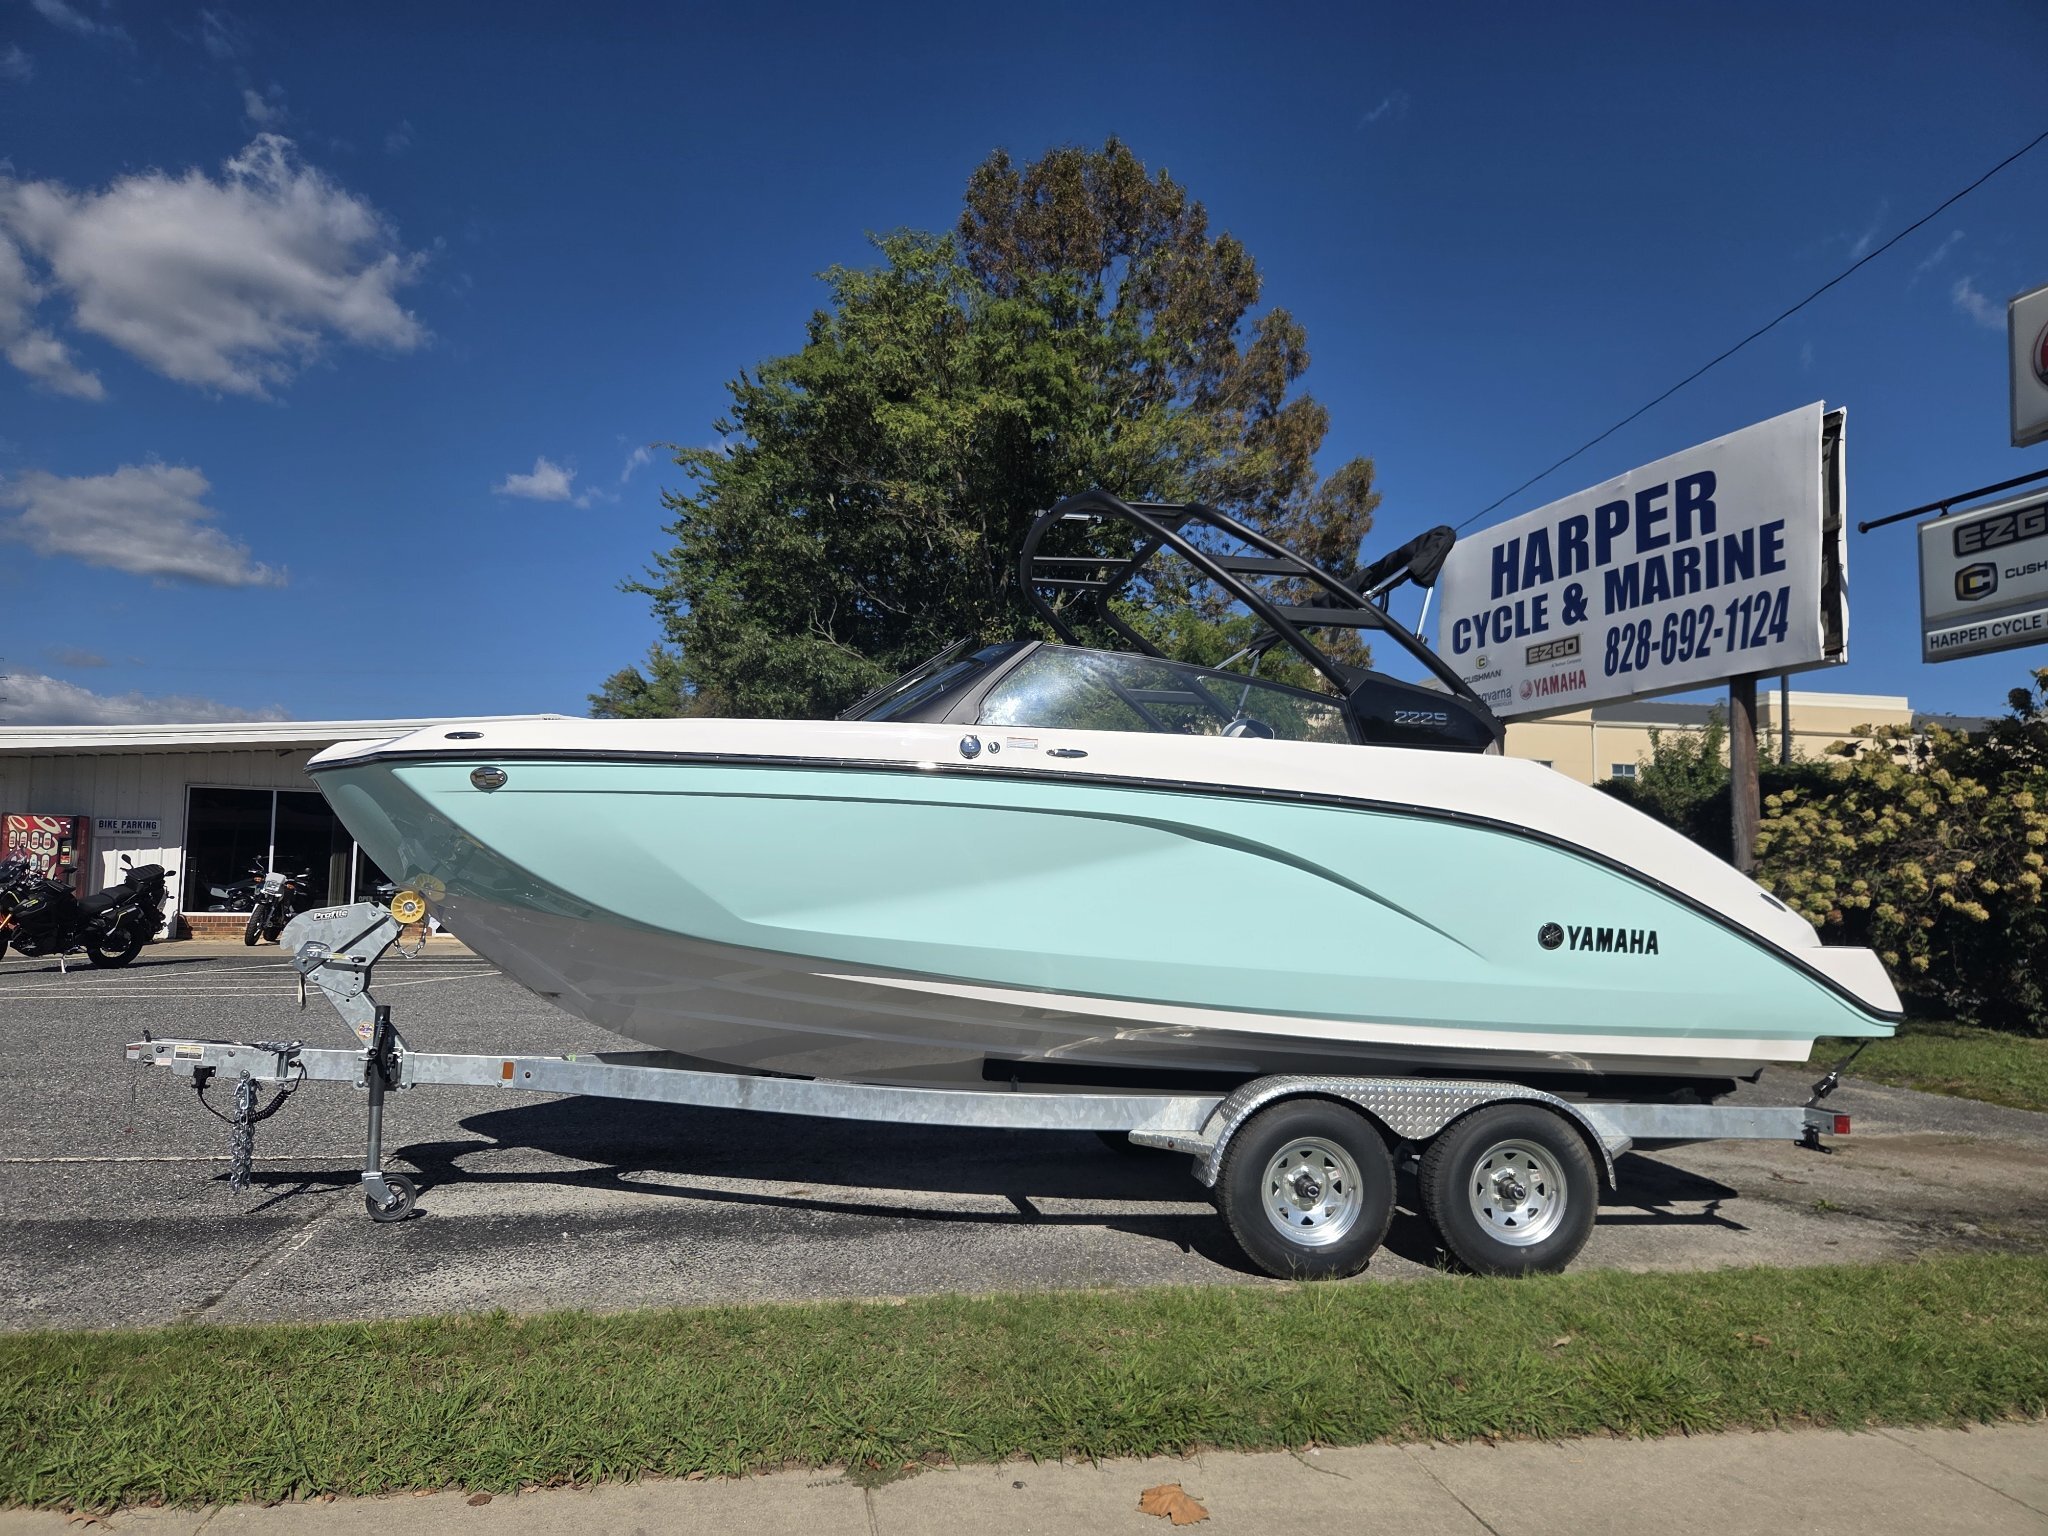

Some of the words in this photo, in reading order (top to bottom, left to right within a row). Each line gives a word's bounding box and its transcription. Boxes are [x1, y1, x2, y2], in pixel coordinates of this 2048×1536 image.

[1491, 470, 1717, 600] HARPER
[1958, 505, 2048, 553] EZG
[2005, 560, 2048, 579] CUSH
[1452, 594, 1549, 655] CYCLE
[1561, 583, 1588, 626] &
[1604, 518, 1786, 616] MARINE
[1604, 586, 1790, 677] 828-692-1124
[1930, 626, 1987, 649] HARPER
[1991, 614, 2042, 638] CYCLE
[1463, 669, 1502, 685] CUSHMAN
[1533, 669, 1587, 697] YAMAHA
[98, 820, 118, 829] BIKE
[121, 820, 157, 829] PARKING
[313, 909, 349, 921] Profile
[1566, 925, 1659, 955] YAMAHA
